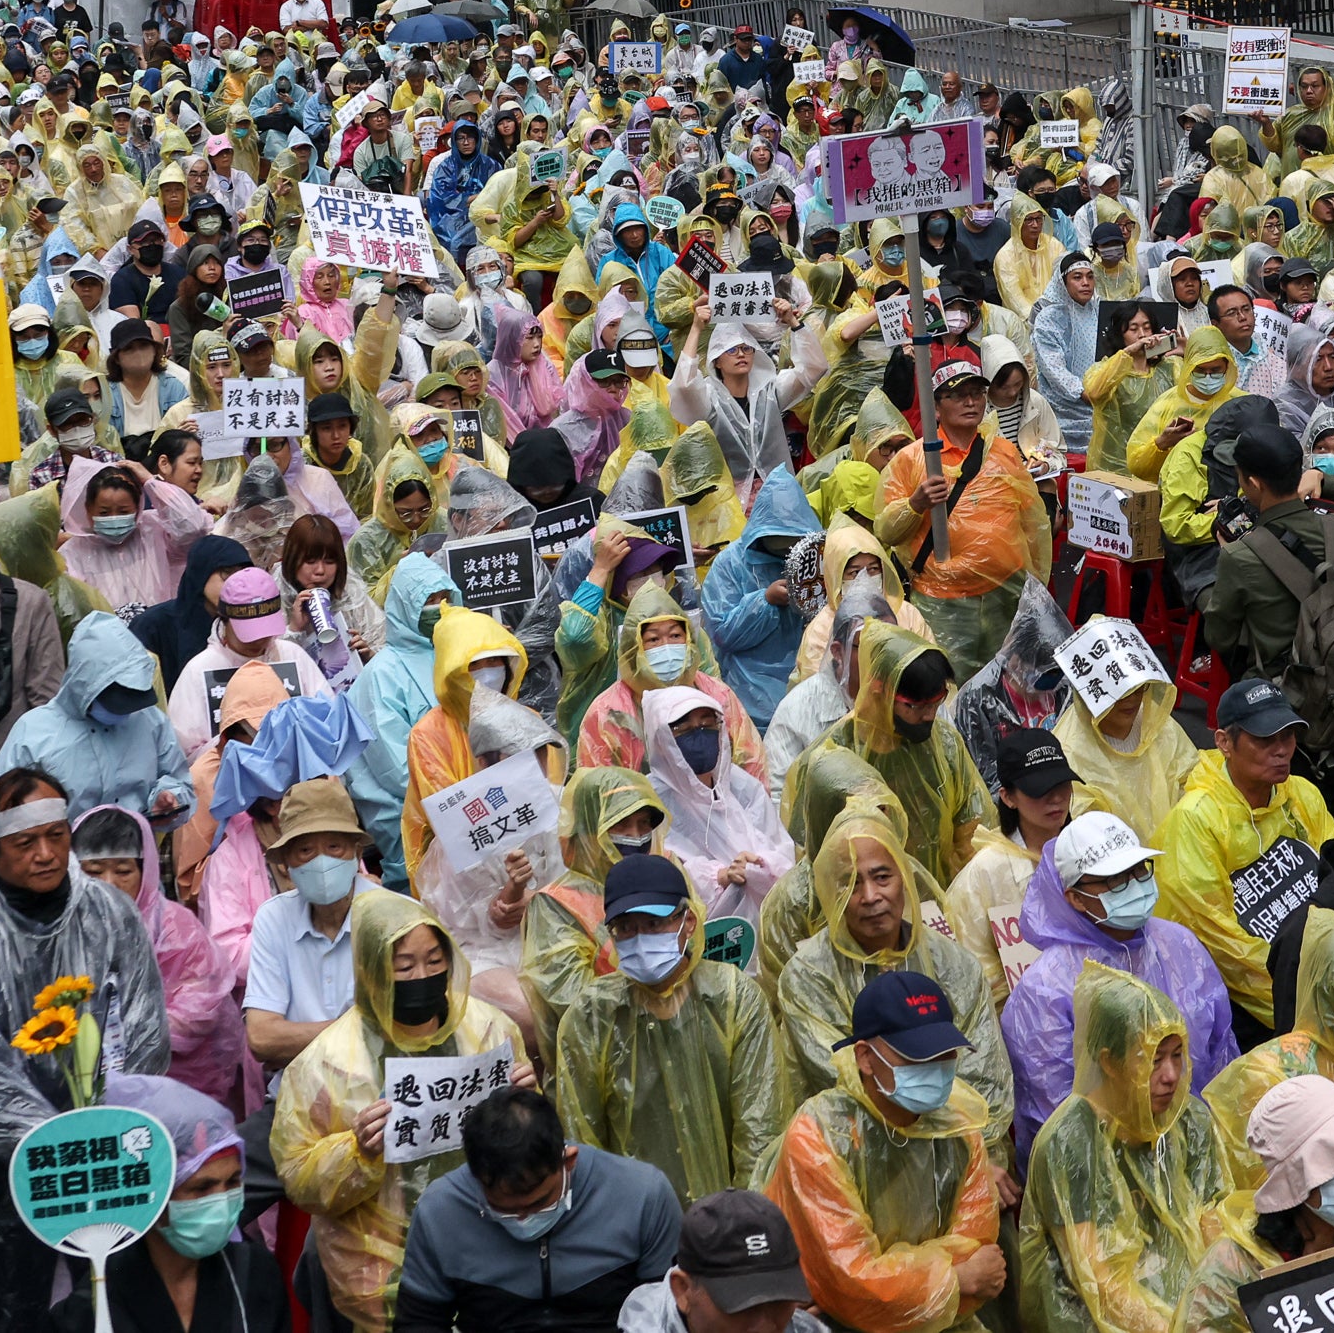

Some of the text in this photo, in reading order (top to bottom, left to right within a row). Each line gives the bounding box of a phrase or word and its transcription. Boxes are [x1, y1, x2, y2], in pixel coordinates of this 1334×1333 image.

[1230, 87, 1279, 99] 不要衝進去
[312, 194, 415, 239] 假改革
[324, 229, 427, 275] 真擴權
[713, 280, 772, 299] 退回法案
[713, 299, 772, 318] 實質審查
[227, 387, 300, 409] 沒有討論
[227, 410, 300, 430] 不是民主
[534, 514, 590, 540] 共同路人
[463, 551, 519, 574] 沒有討論
[466, 569, 522, 591] 不是民主
[1070, 631, 1149, 680] 退回法案
[462, 785, 509, 826] 國會
[468, 802, 538, 852] 搞文革
[394, 1059, 510, 1110] 退回法案
[26, 1135, 120, 1172] 我藐視
[29, 1161, 152, 1203] 藍白黑箱
